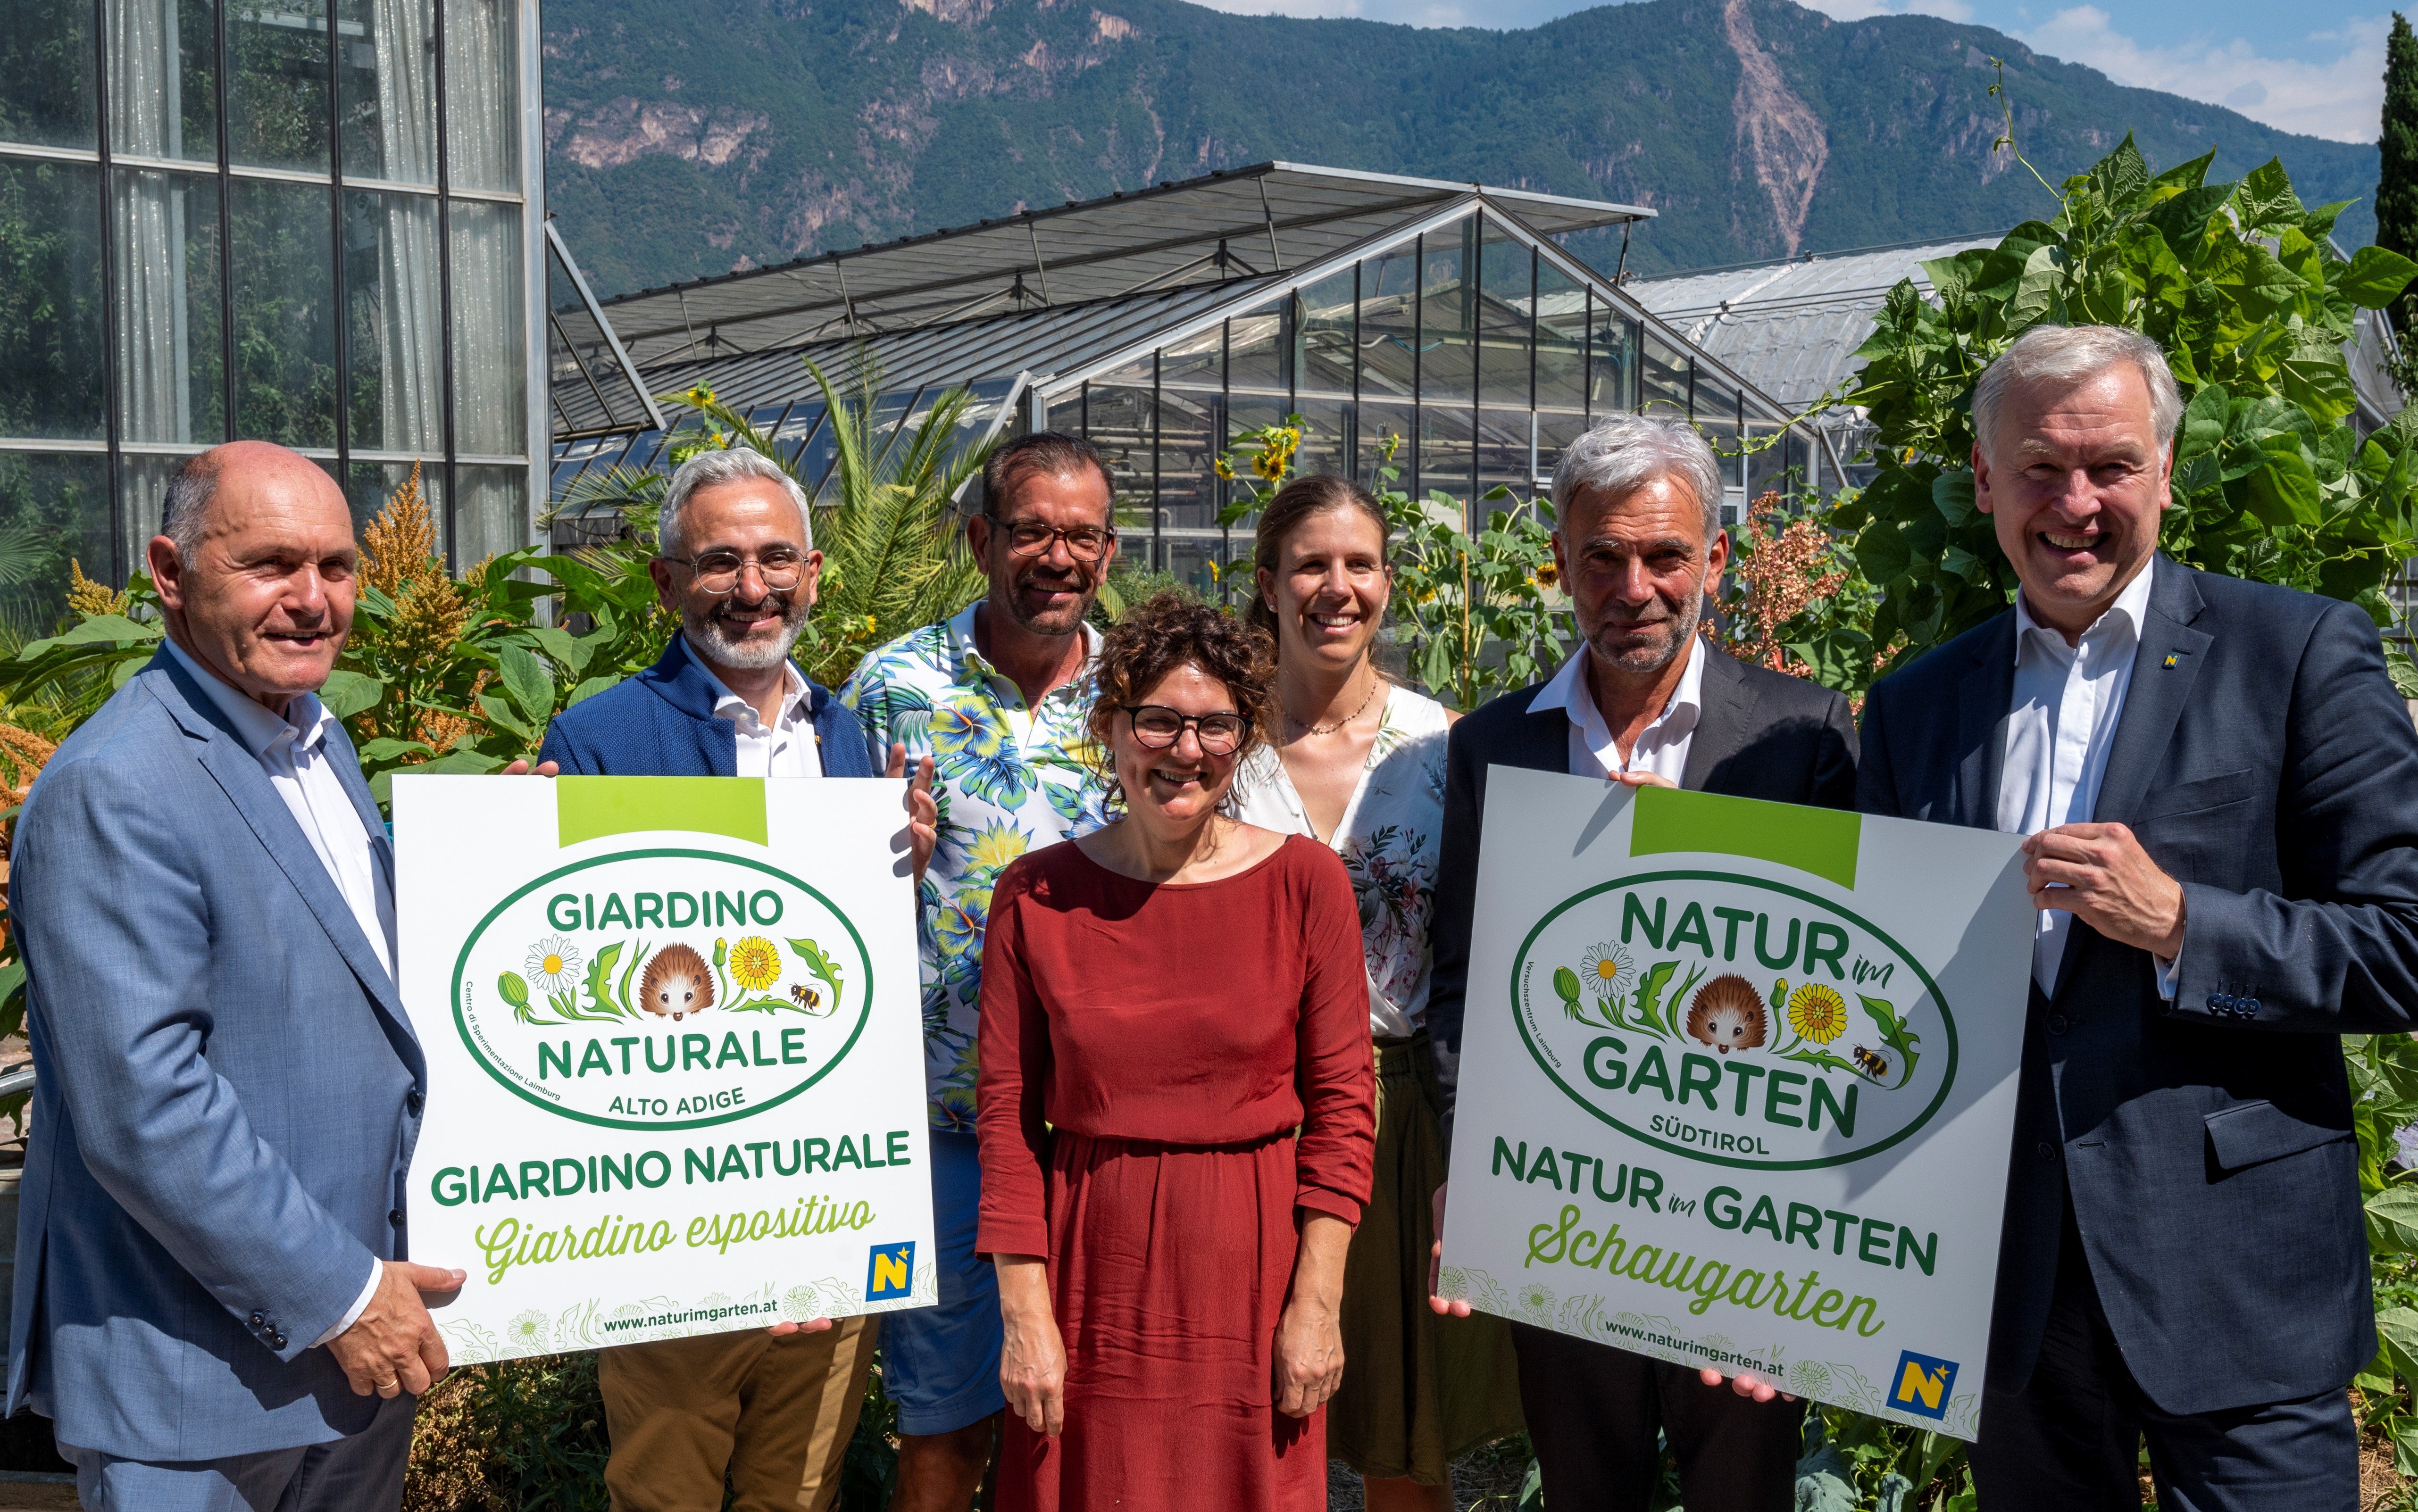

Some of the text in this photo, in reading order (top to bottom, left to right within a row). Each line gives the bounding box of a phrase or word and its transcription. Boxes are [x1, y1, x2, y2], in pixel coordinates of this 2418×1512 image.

[547, 889, 784, 931] GIARDINO
[1620, 892, 1895, 989] NATUR im
[1523, 961, 1562, 1068] Versuchszentrum Laimburg
[469, 1014, 477, 1022] di
[473, 1024, 523, 1081] Sperimentazione
[524, 1078, 561, 1101] Laimburg
[538, 1028, 808, 1080] NATURALE
[1583, 1036, 1859, 1138] GARTEN
[609, 1087, 746, 1116] ALTO ADIGE
[1650, 1114, 1770, 1155] SÜDTIROL
[431, 1130, 911, 1207] GIARDINO NATURALE
[1491, 1135, 1938, 1277] NATUR im GARTEN
[475, 1195, 876, 1286] Giardino espositivo
[873, 1253, 909, 1293] N
[1524, 1203, 1885, 1338] Schaugarten
[603, 1299, 778, 1333] www.naturimgarten.at
[1605, 1320, 1784, 1379] www.naturimgarten.at
[1897, 1362, 1944, 1410] N
